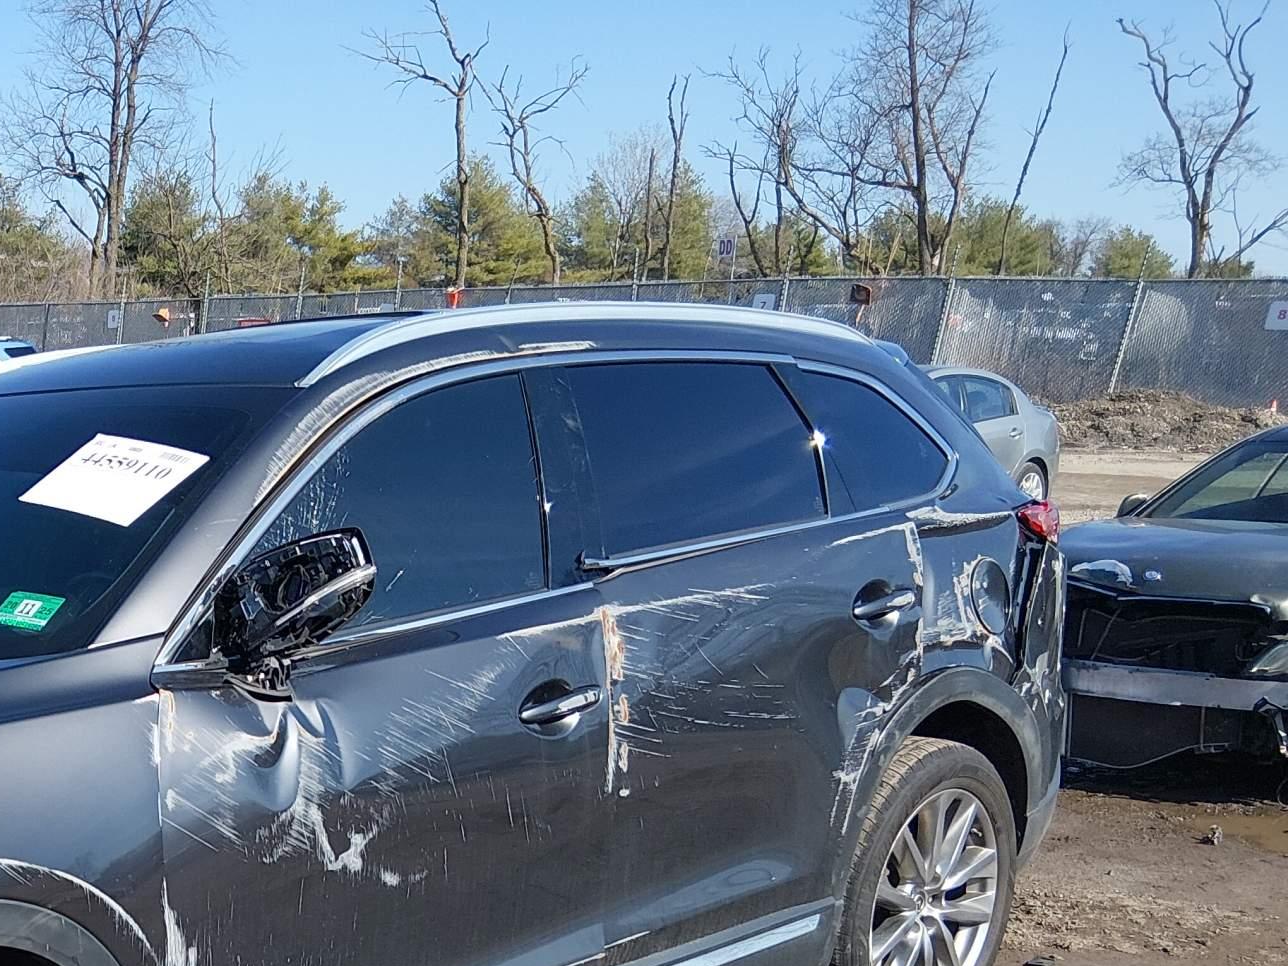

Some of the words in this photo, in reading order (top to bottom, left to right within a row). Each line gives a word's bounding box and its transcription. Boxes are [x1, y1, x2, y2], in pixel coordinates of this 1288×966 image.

[718, 239, 733, 256] DD
[81, 452, 173, 480] 44559110
[17, 602, 37, 615] 11
